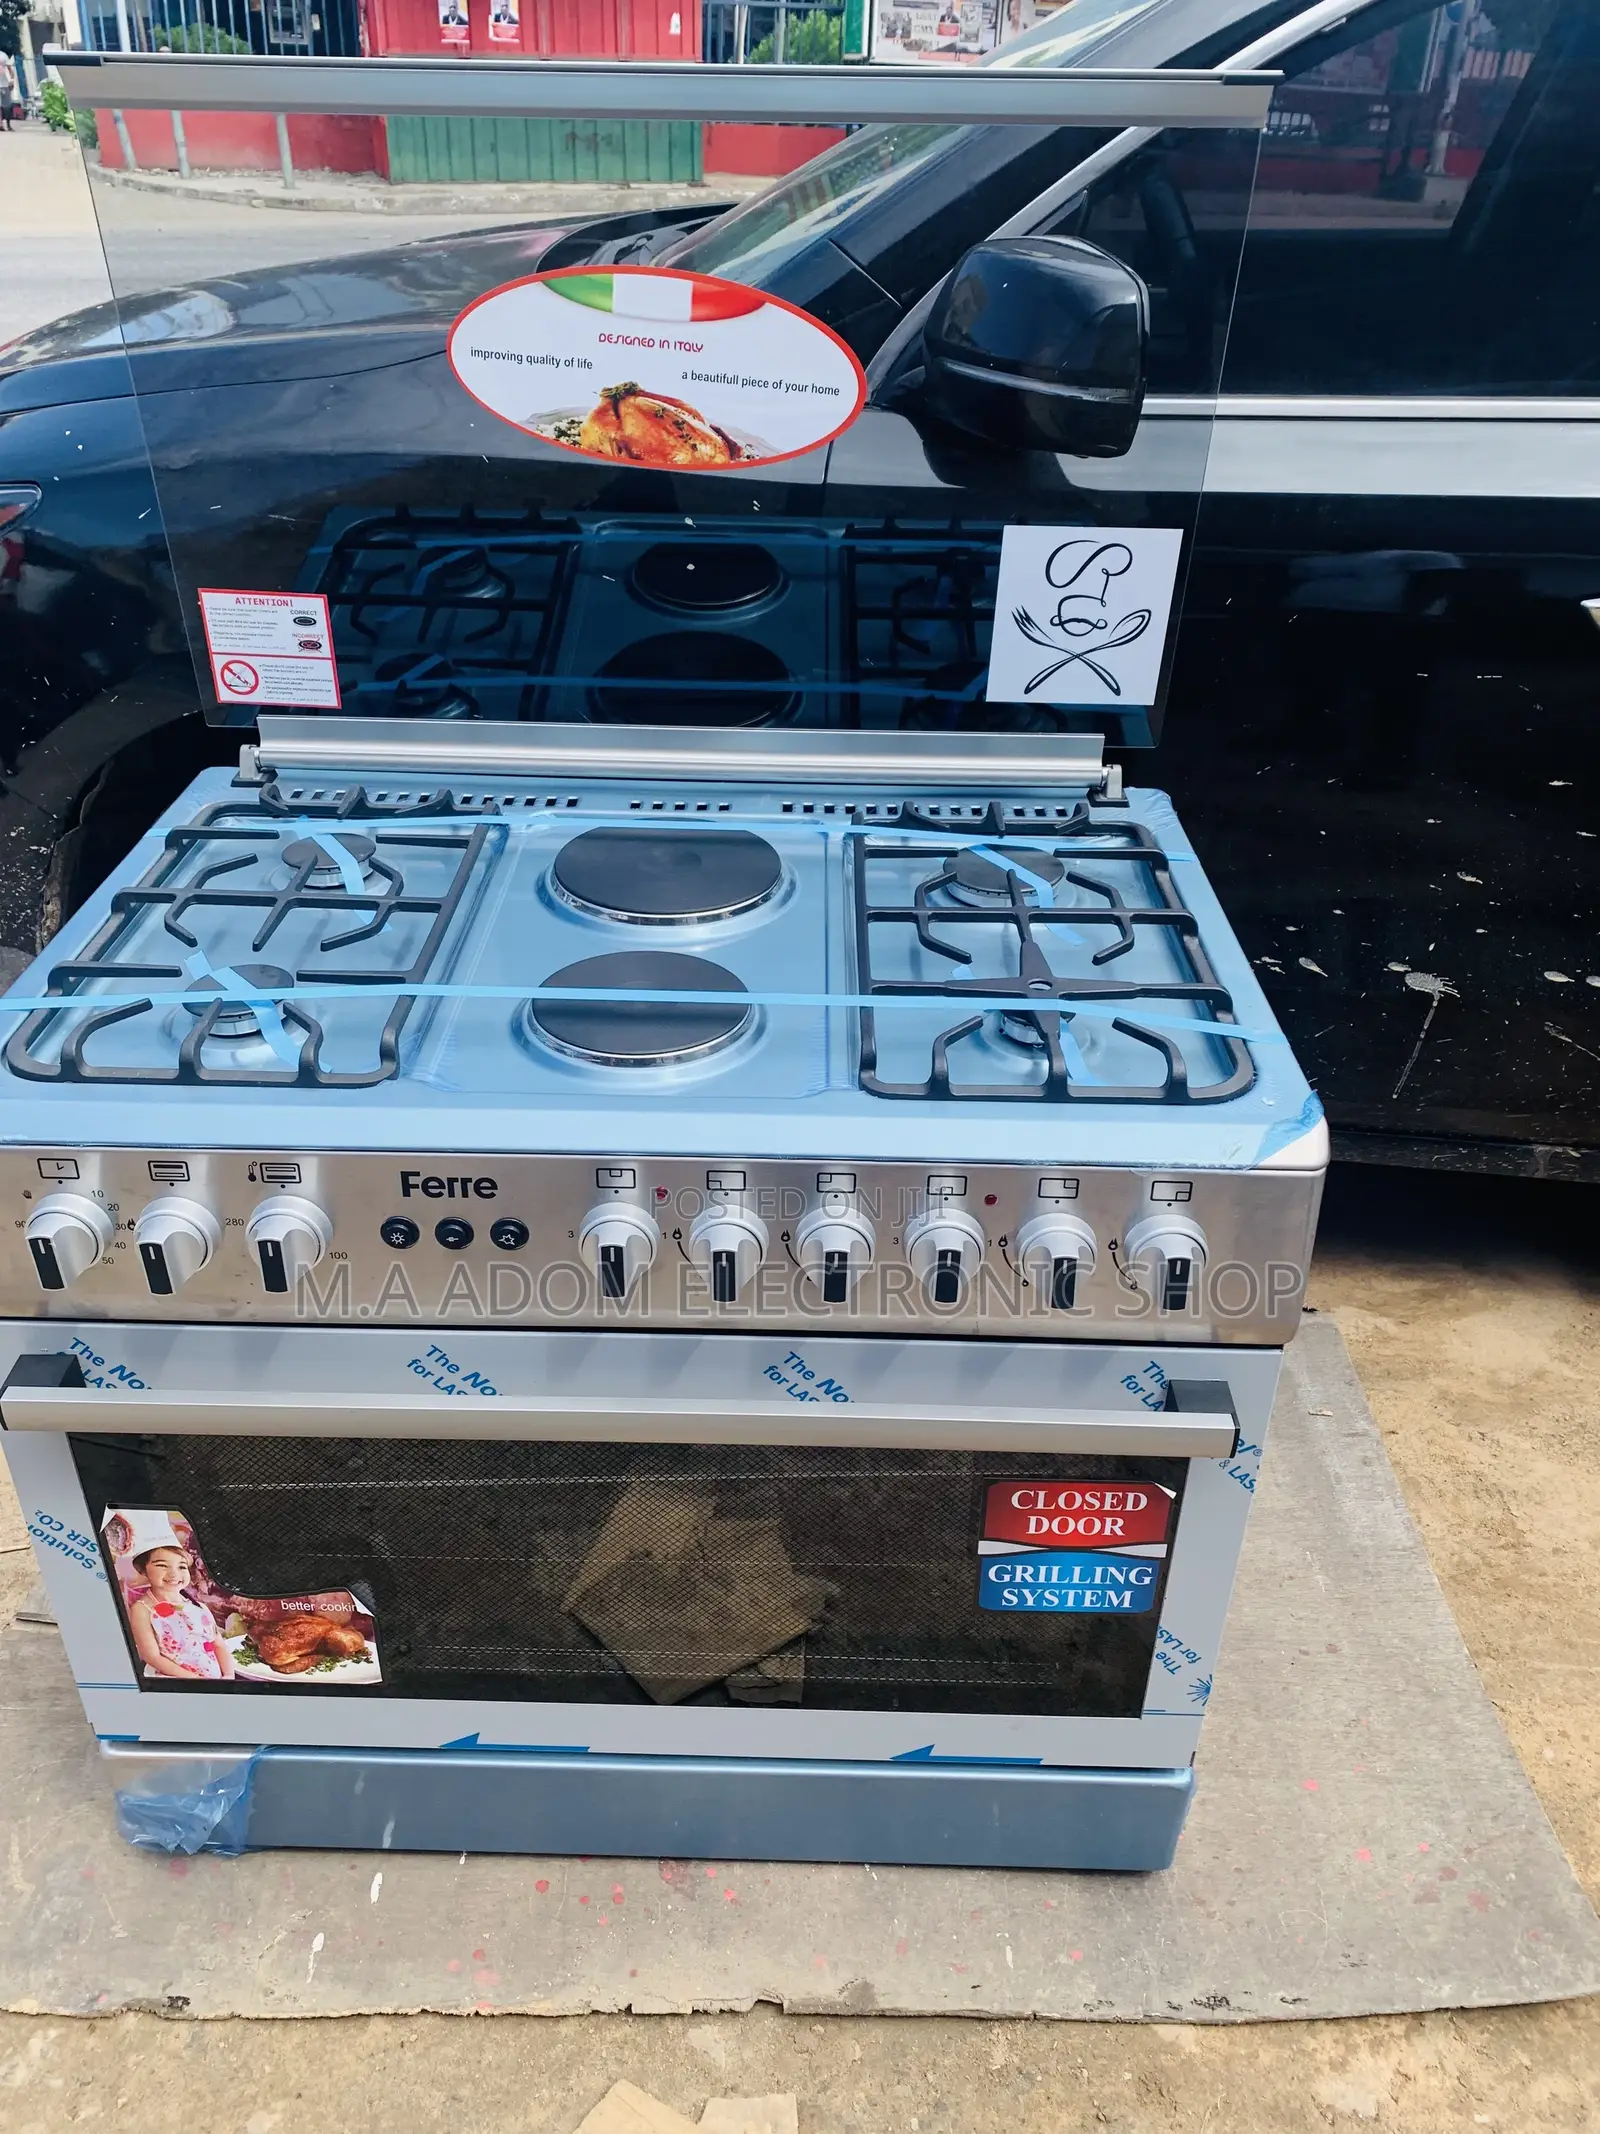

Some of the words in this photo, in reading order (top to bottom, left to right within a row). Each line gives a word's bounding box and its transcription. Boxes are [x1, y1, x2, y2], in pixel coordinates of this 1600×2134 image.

[599, 333, 655, 348] DESIGNED
[659, 339, 670, 349] IN
[674, 341, 703, 353] ITALY
[470, 346, 523, 364] improving
[526, 354, 561, 369] quality
[564, 357, 574, 368] of
[577, 358, 593, 370] life
[682, 371, 688, 380] a
[691, 370, 738, 385] beautifull
[741, 376, 769, 389] piece
[772, 379, 783, 390] of
[785, 381, 808, 394] your
[811, 383, 840, 396] home
[235, 597, 294, 608] ATTENTION!
[92, 1190, 104, 1198] 10
[401, 1170, 498, 1199] Ferre
[107, 1203, 120, 1212] 20
[115, 1223, 126, 1231] 30
[225, 1218, 244, 1226] 280
[568, 1230, 574, 1238] 3
[893, 1237, 899, 1245] 3
[114, 1242, 126, 1250] 40
[329, 1252, 348, 1260] 100
[102, 1257, 114, 1265] 50
[69, 1337, 105, 1367] The
[108, 1364, 152, 1390] No
[406, 1358, 435, 1378] for
[426, 1344, 460, 1374] The
[461, 1371, 503, 1396] No
[763, 1365, 789, 1385] for
[784, 1351, 815, 1380] The
[815, 1378, 855, 1403] No
[1120, 1374, 1146, 1394] for
[1228, 1466, 1256, 1494] LAS
[1011, 1489, 1148, 1512] CLOSED
[1026, 1515, 1125, 1536] DOOR
[67, 1529, 101, 1556] SER
[988, 1564, 1153, 1586] GRILLING
[280, 1599, 315, 1611] better
[1001, 1588, 1134, 1609] SYSTEM
[1157, 1626, 1183, 1650] LAS
[1155, 1652, 1181, 1675] The
[1180, 1648, 1202, 1664] for
